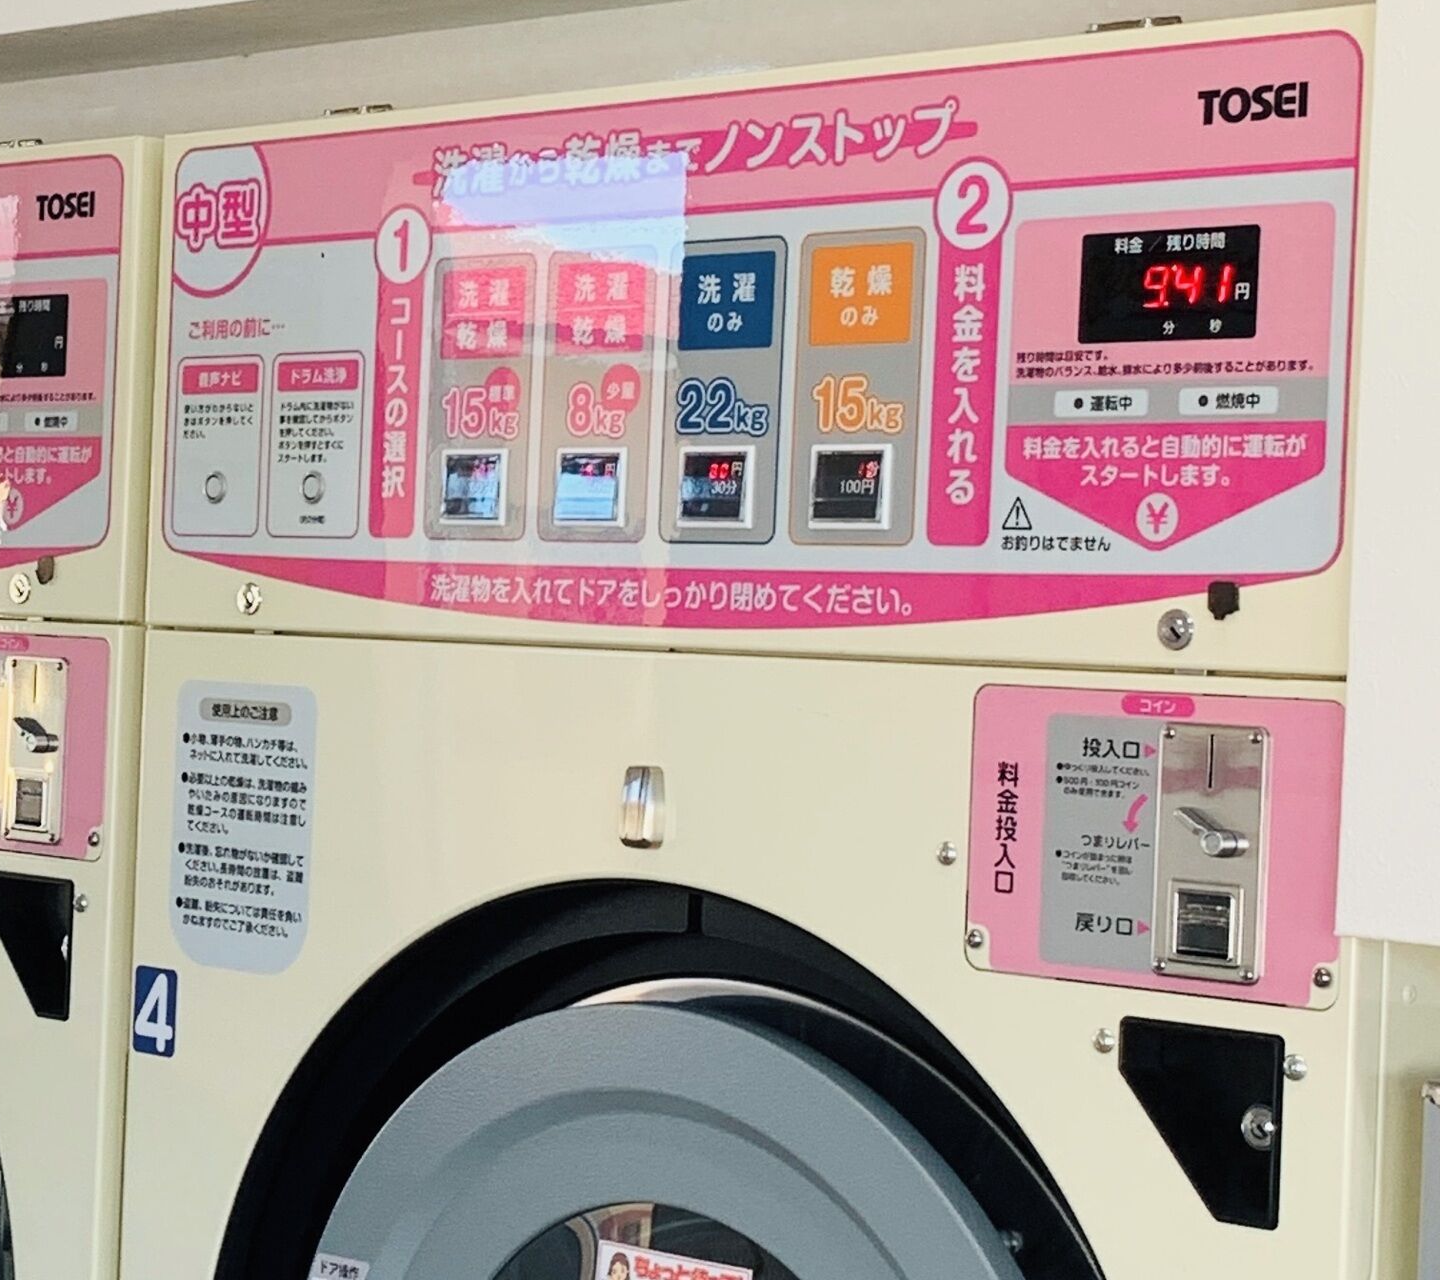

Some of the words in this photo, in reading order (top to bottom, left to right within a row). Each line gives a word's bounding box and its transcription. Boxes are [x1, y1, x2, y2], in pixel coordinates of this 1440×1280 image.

[1198, 81, 1310, 126] TOSEI
[36, 192, 97, 221] TOSEI
[175, 178, 260, 253] 中型
[956, 175, 990, 236] 2
[393, 221, 411, 272] 1
[1166, 232, 1226, 252] 残り時間
[458, 278, 511, 310] 洗濯
[573, 272, 628, 303] 洗濯
[696, 272, 757, 305] 洗濯
[829, 265, 893, 298] 乾燥
[1234, 282, 1250, 300] 円
[572, 314, 627, 346] 乾燥
[707, 311, 743, 334] のみ
[839, 306, 879, 327] のみ
[1162, 320, 1175, 336] 分
[1209, 319, 1222, 333] 秒
[381, 297, 413, 500] コースの選択
[945, 264, 987, 506] 料金を入れる
[1090, 395, 1133, 412] 運転中
[1216, 392, 1261, 410] 燃焼中
[442, 387, 519, 439] 15kg
[566, 381, 626, 438] 8kg
[676, 377, 770, 437] 22kg
[812, 376, 905, 435] 15kg
[1023, 433, 1307, 459] 料金を入れると自動的に運転が
[1080, 464, 1231, 487] スタートします。
[1001, 536, 1111, 552] お釣りはでません
[430, 572, 913, 618] 洗濯物を入れてドアをしっかり閉めてください。
[1139, 698, 1176, 714] コイン
[1082, 737, 1140, 759] 投入口
[993, 761, 1020, 895] 料金投入口
[1080, 834, 1151, 851] つまりレバー
[1074, 912, 1133, 936] 戻り口
[134, 972, 173, 1053] 4
